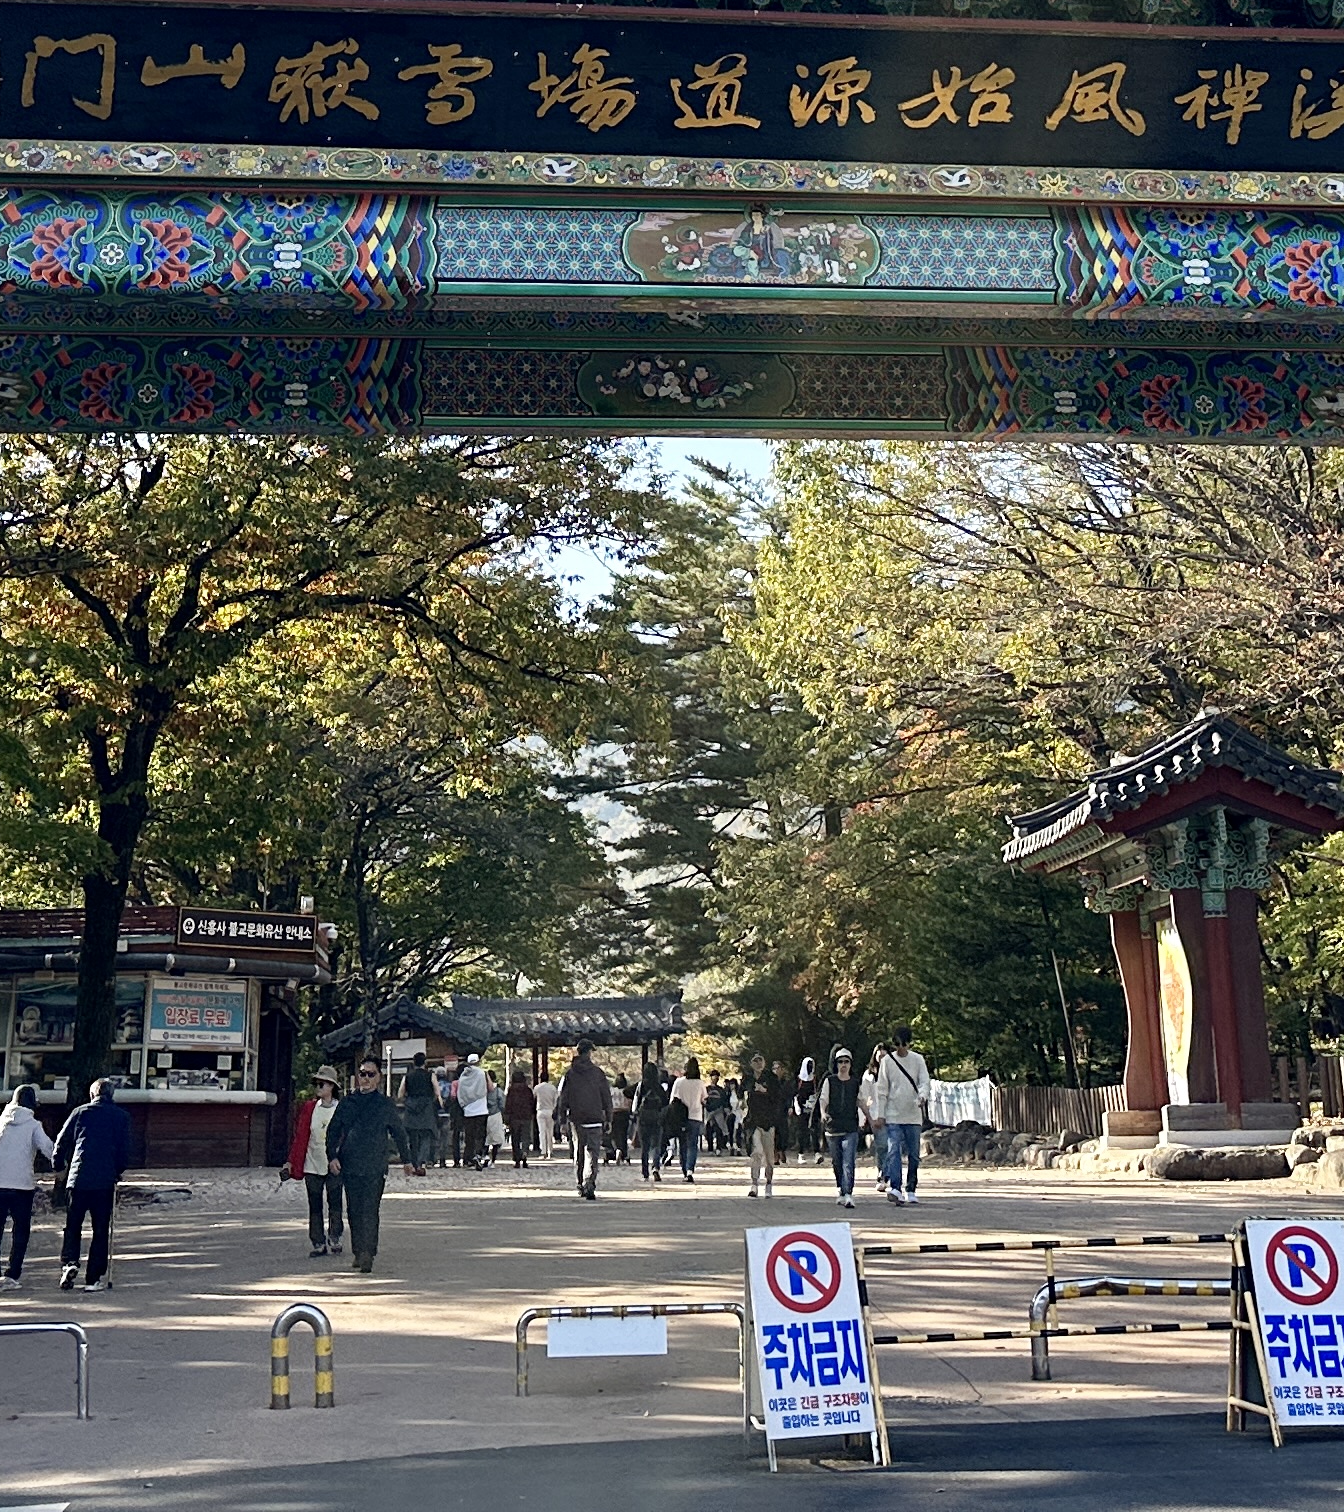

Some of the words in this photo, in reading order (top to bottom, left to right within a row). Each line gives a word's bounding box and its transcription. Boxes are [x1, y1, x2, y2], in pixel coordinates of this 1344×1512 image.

[198, 919, 226, 936] 신흥사
[285, 925, 313, 941] 안내소
[165, 1007, 200, 1026] 입장료
[203, 1008, 232, 1027] 무료!
[762, 1319, 866, 1390] 주차금지
[768, 1398, 798, 1412] 이곳은
[800, 1395, 819, 1410] 긴급
[823, 1391, 869, 1408] 구조차량이
[1273, 1385, 1301, 1399] 이곳은
[1303, 1385, 1323, 1399] 긴급
[782, 1414, 820, 1429] 출입하는
[822, 1409, 861, 1426] 곳입니다
